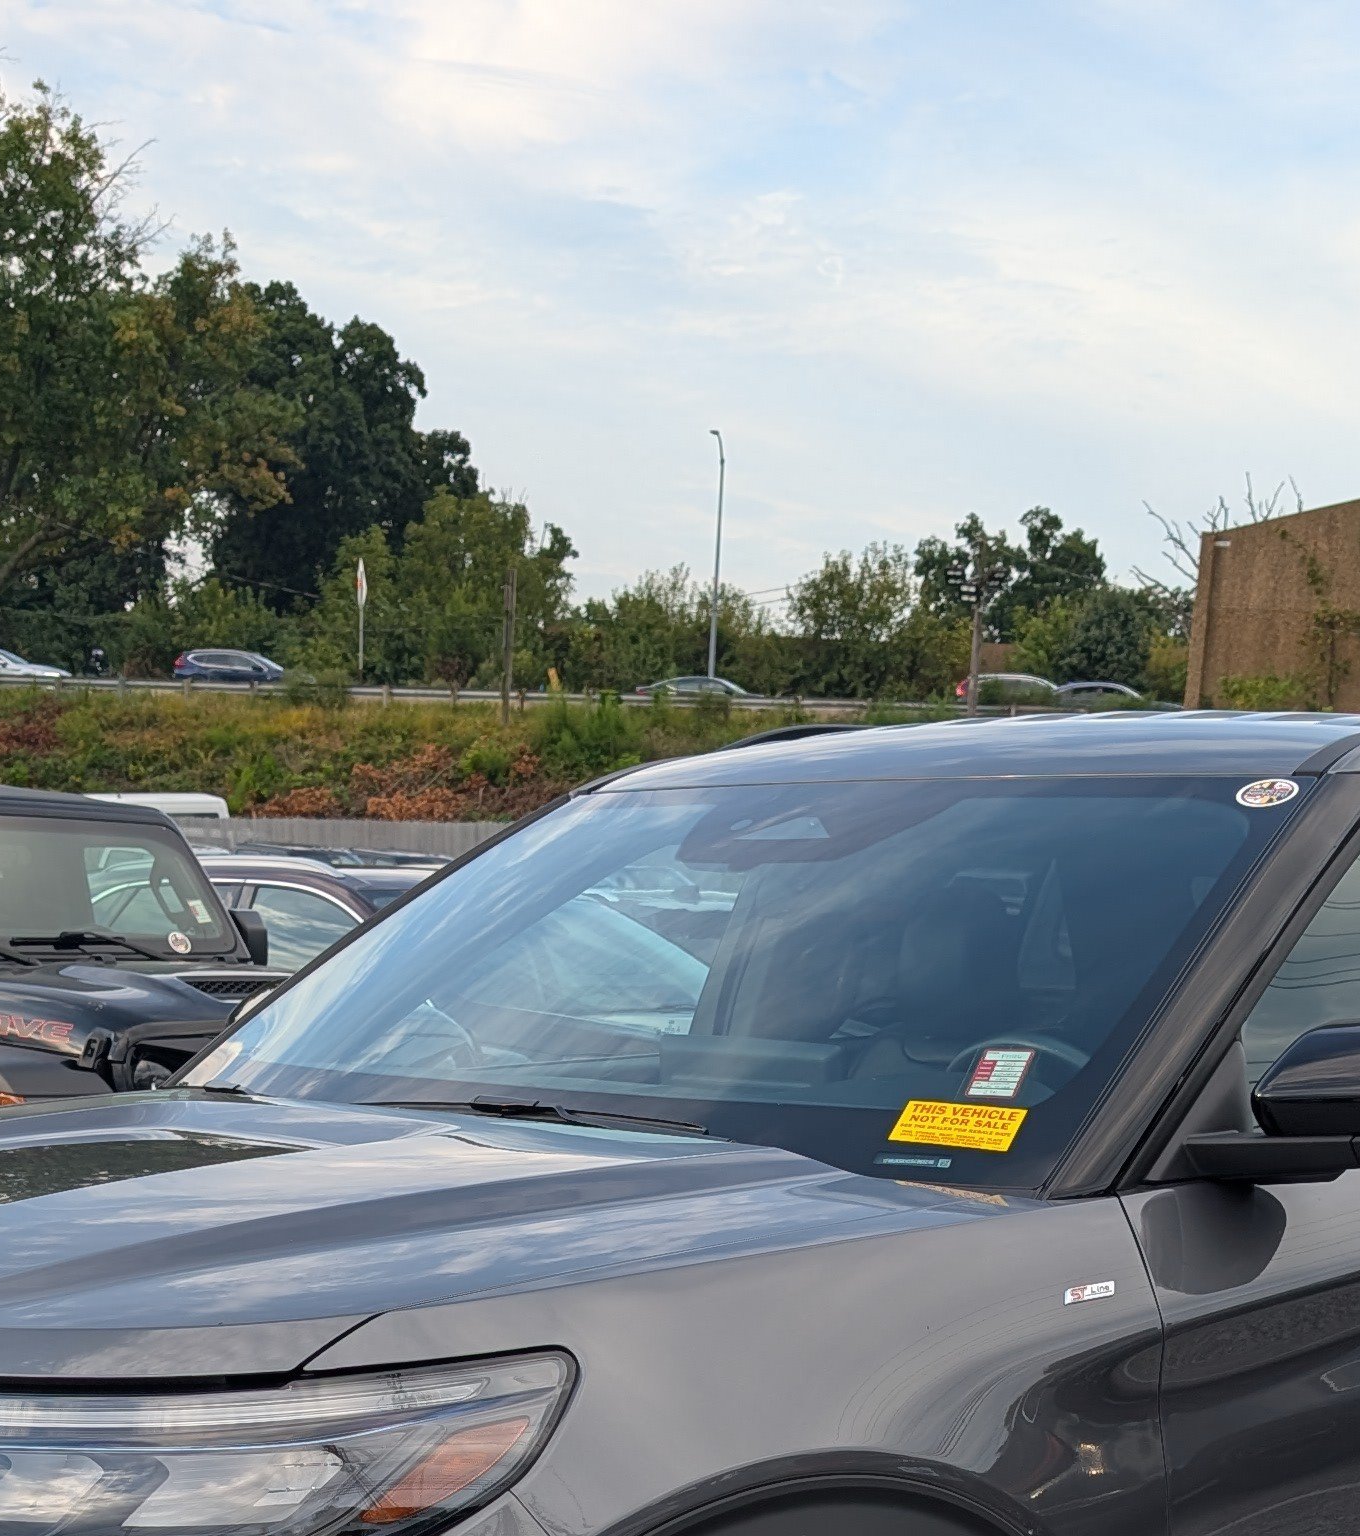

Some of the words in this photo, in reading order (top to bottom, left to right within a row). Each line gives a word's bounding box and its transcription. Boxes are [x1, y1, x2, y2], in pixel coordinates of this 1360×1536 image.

[912, 1103, 948, 1115] THIS
[952, 1106, 1020, 1122] VEHICLE
[909, 1114, 940, 1124] NOT
[941, 1116, 971, 1127] FOR
[973, 1119, 1012, 1131] SALE
[1070, 1285, 1088, 1301] ST
